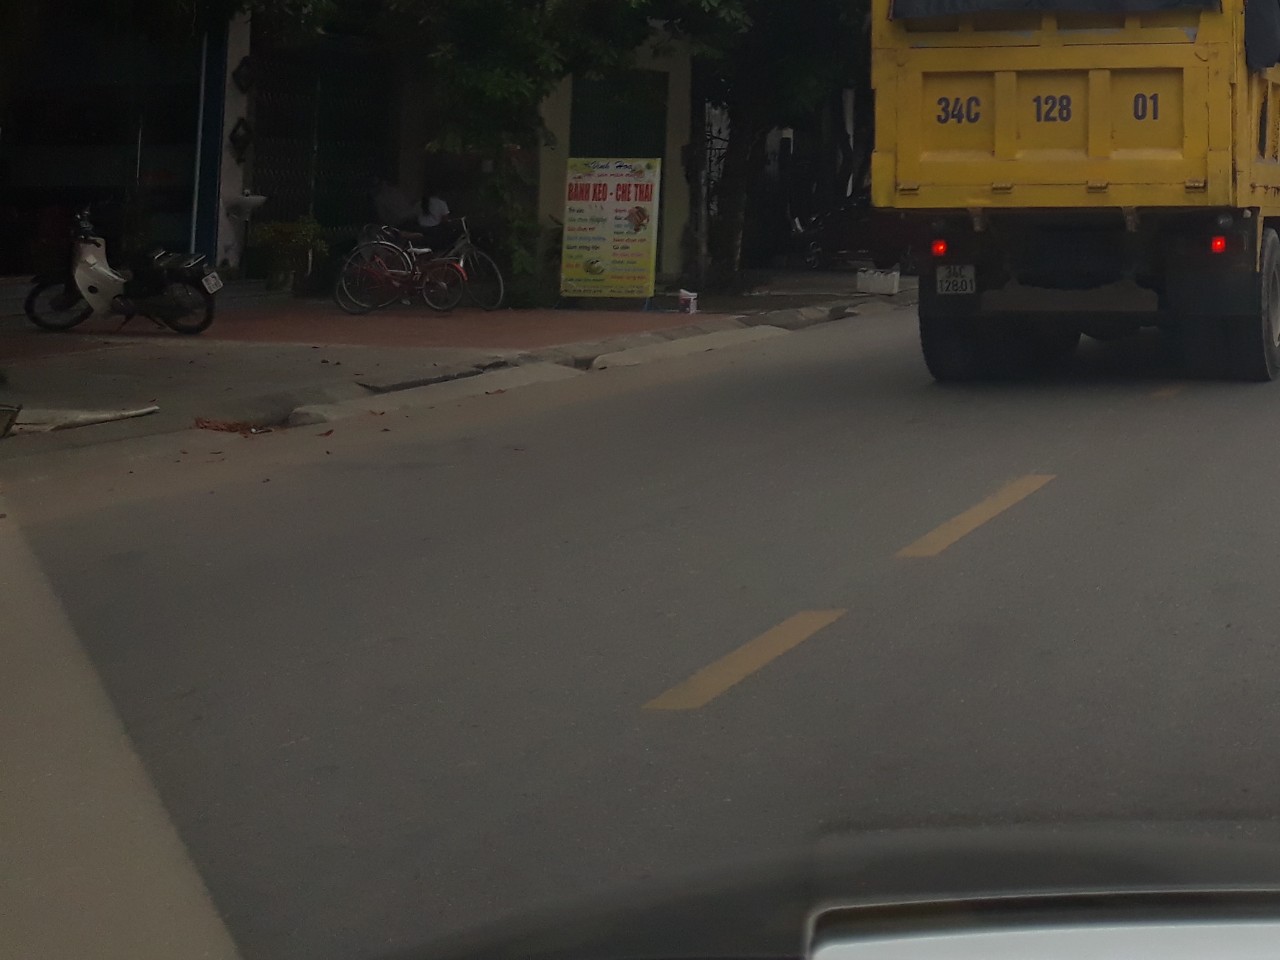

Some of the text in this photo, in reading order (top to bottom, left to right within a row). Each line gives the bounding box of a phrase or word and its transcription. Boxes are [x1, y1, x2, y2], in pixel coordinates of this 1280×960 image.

[936, 96, 982, 125] 34C
[1032, 94, 1073, 123] 128
[1133, 92, 1160, 121] 01
